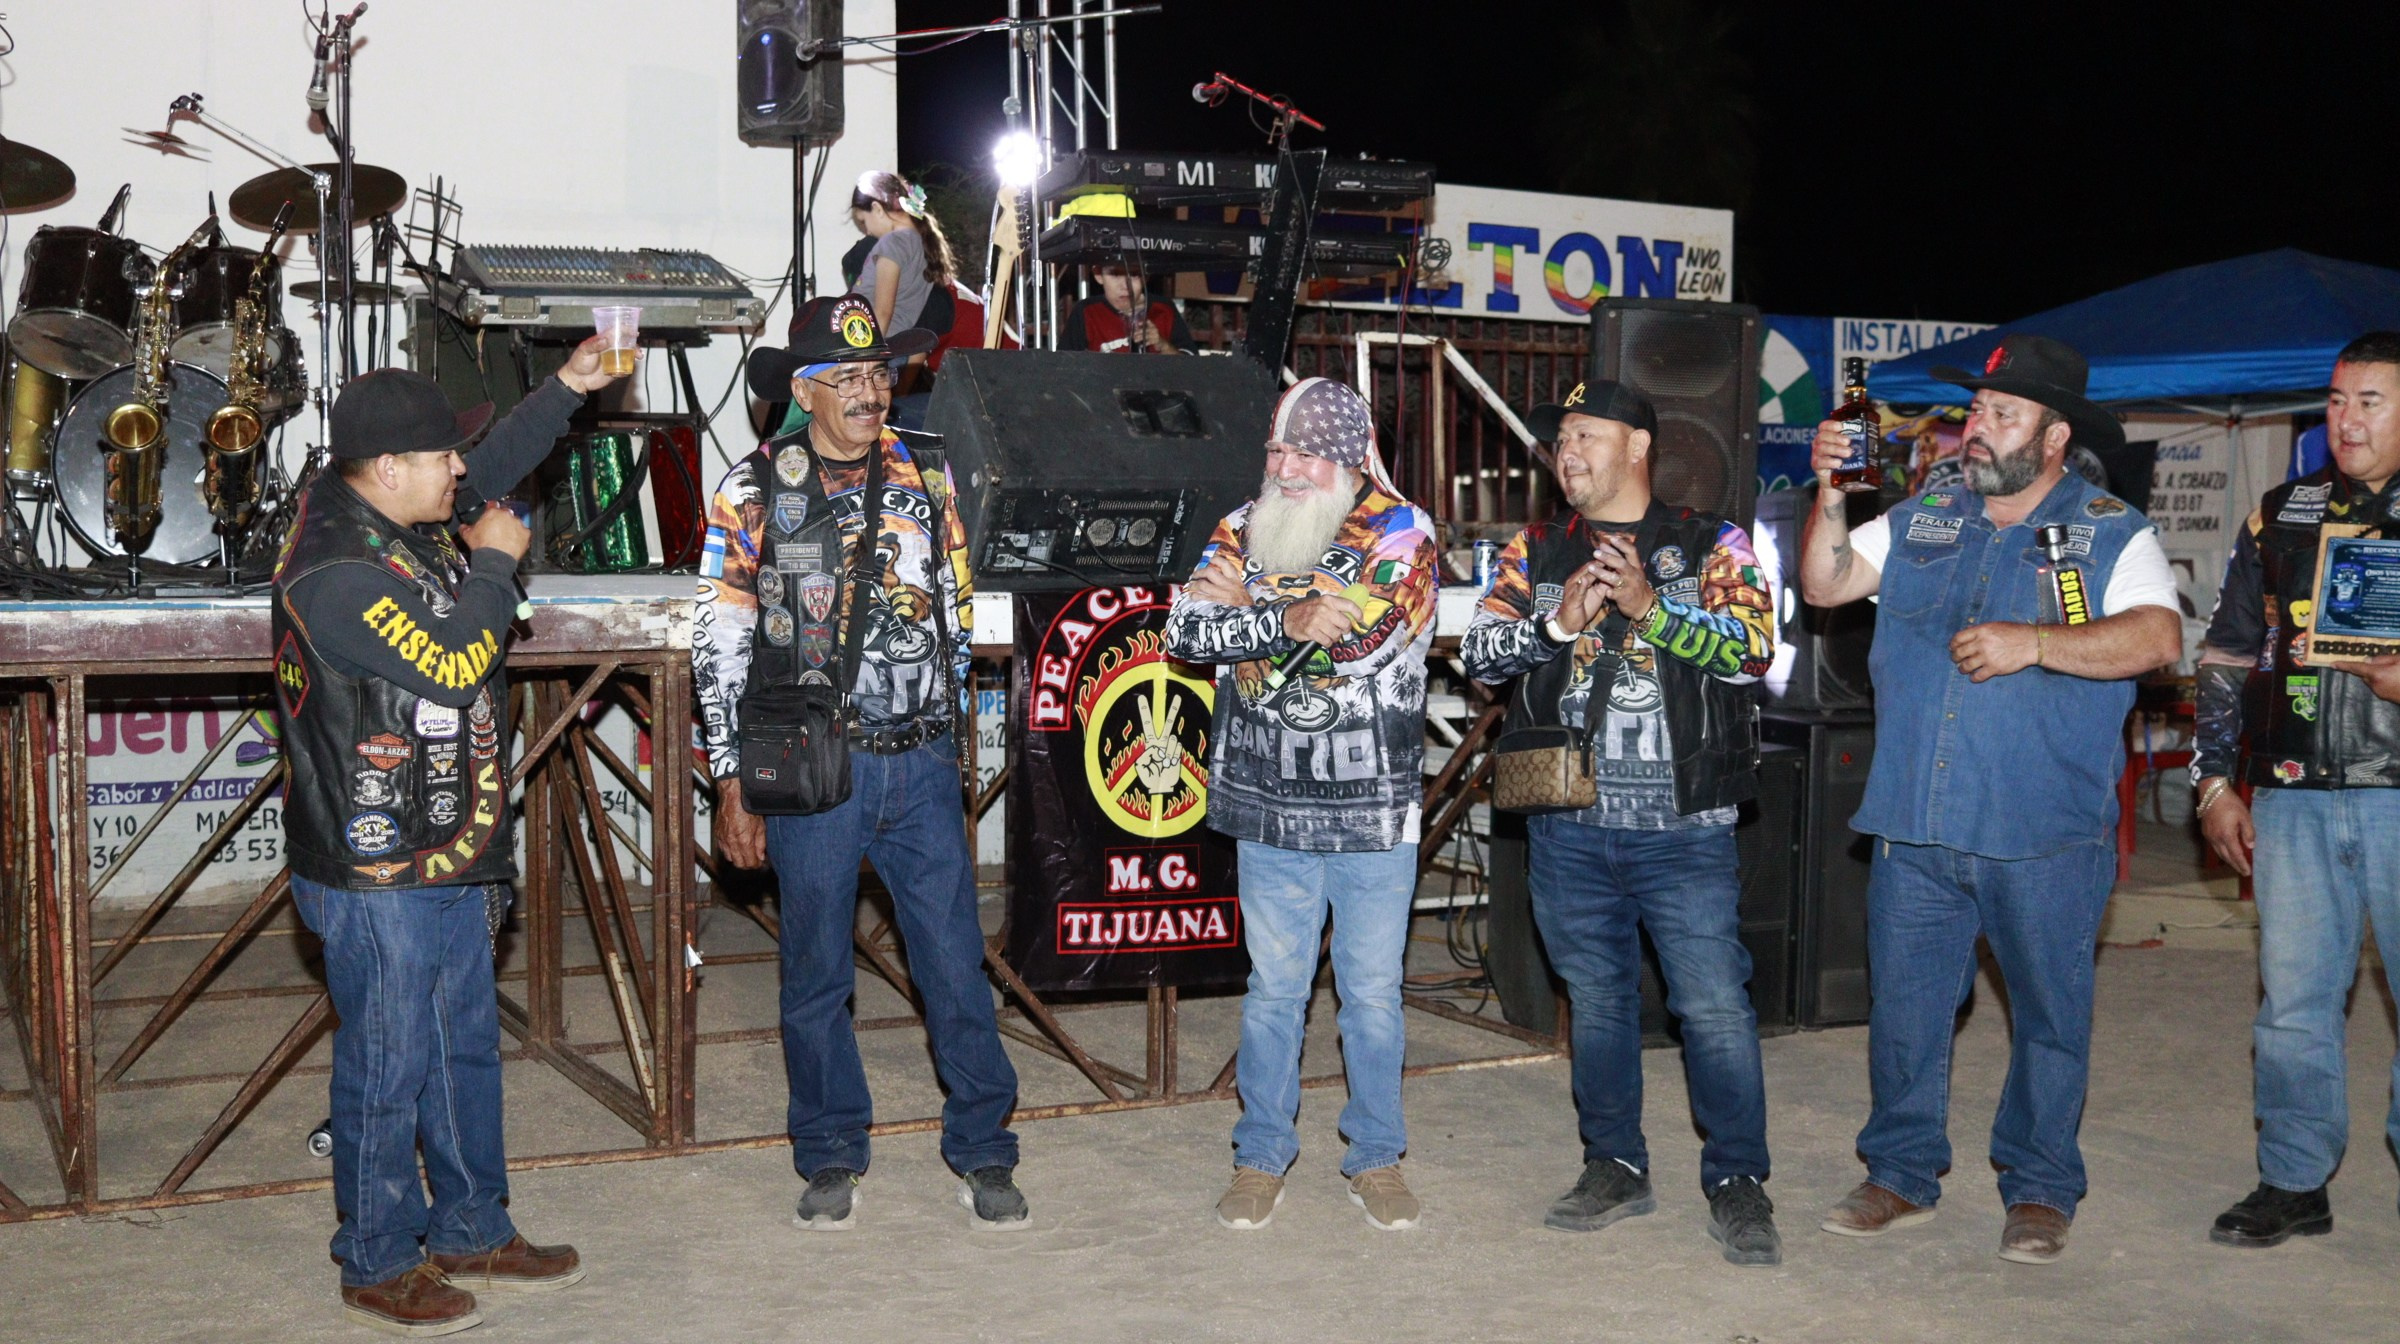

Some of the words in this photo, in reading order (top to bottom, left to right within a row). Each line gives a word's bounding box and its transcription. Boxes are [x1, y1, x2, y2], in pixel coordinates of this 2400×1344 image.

[1177, 160, 1216, 187] M1
[1686, 247, 1721, 271] NVO.
[832, 301, 852, 331] PEACE
[1914, 515, 1959, 530] PERALTA
[780, 547, 819, 555] PRESIDENTE
[362, 596, 499, 691] ENSENADA
[1331, 606, 1406, 663] COLORADO
[1642, 607, 1745, 674] LUIS
[1034, 583, 1156, 726] PEACE
[151, 786, 162, 802] y
[1279, 780, 1379, 801] COLORADO
[93, 816, 108, 838] Y
[115, 815, 138, 837] 10
[1108, 855, 1152, 892] M.
[1158, 854, 1197, 889] G.
[1061, 906, 1229, 944] TIJUANA
